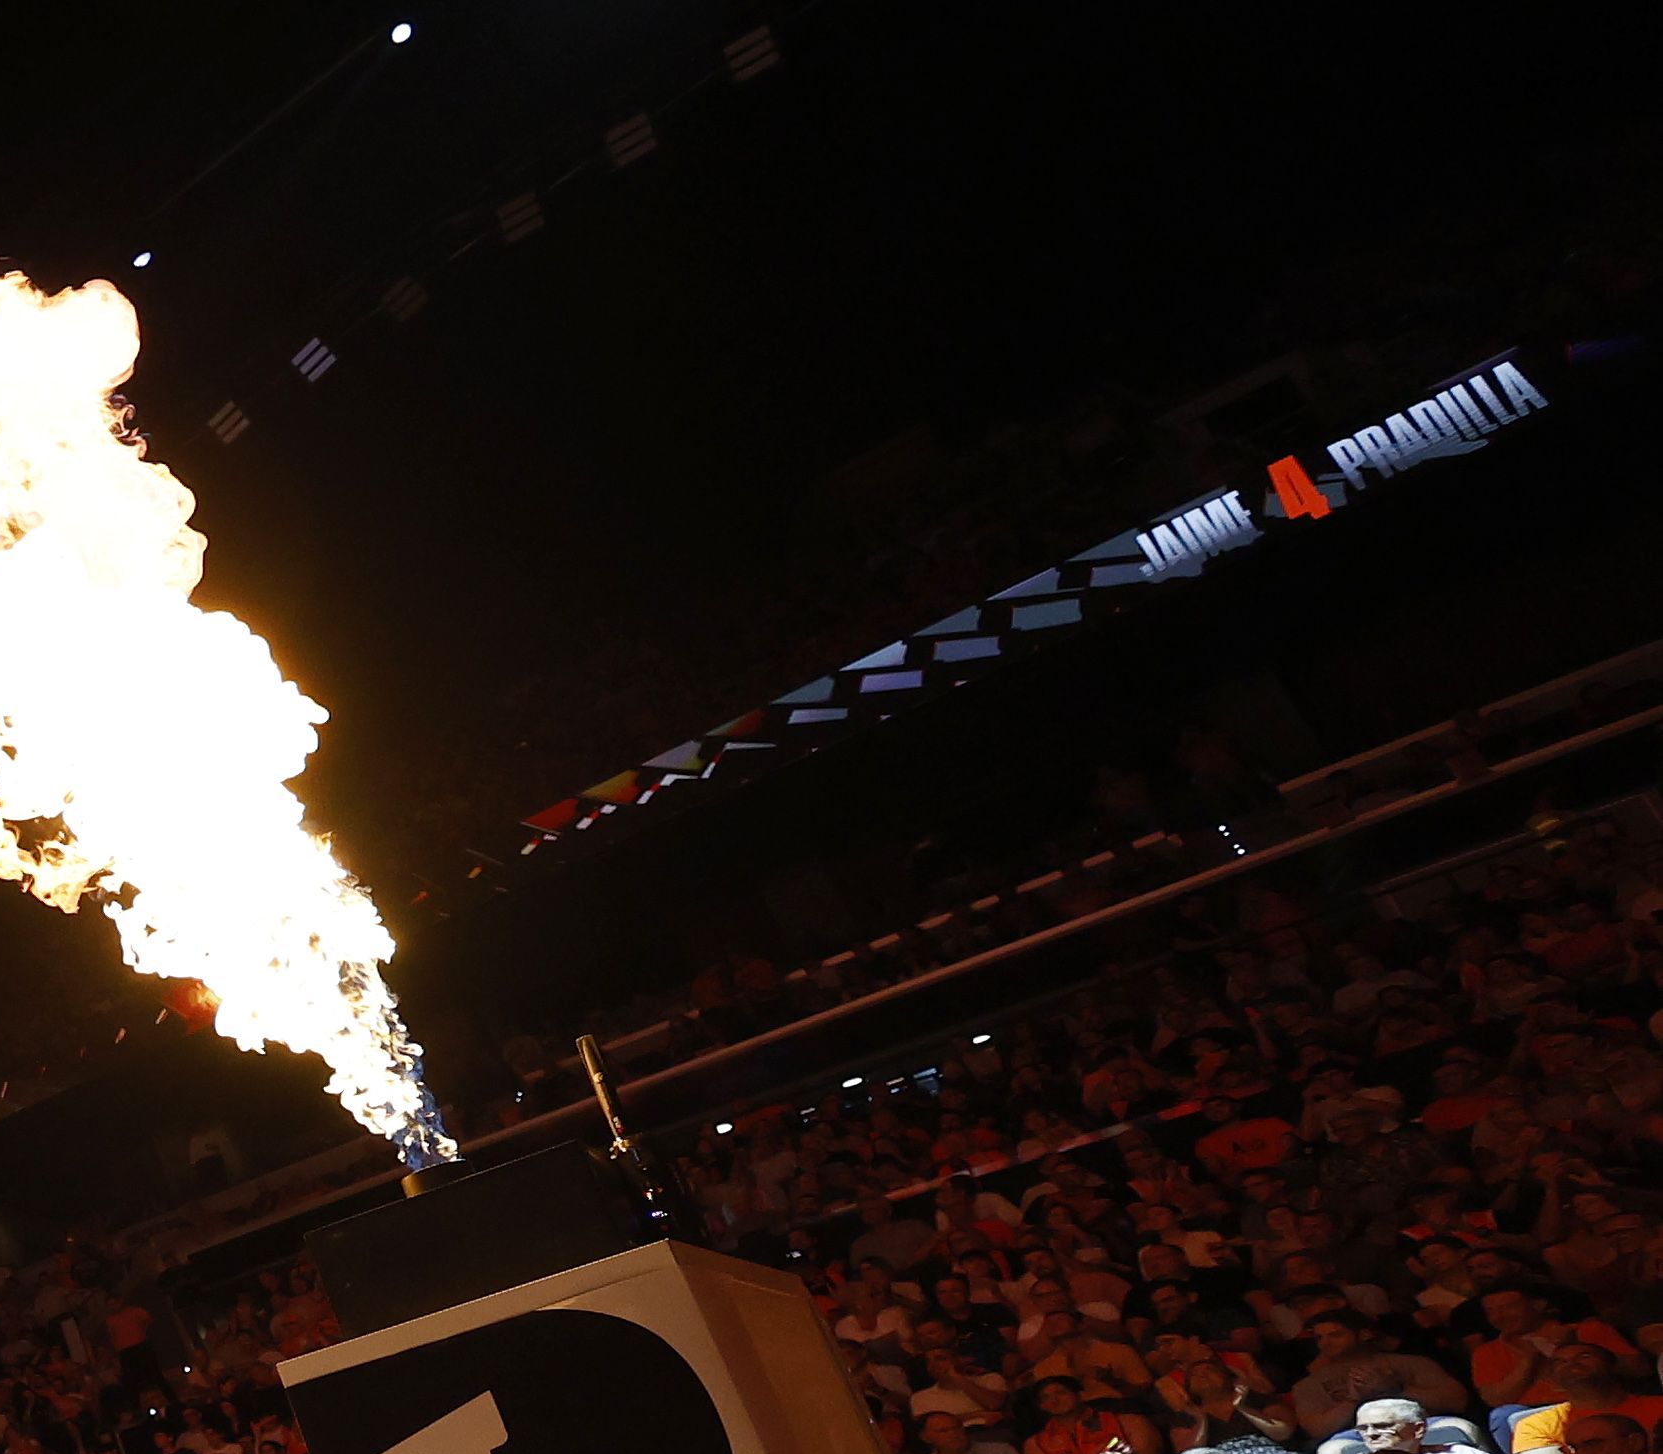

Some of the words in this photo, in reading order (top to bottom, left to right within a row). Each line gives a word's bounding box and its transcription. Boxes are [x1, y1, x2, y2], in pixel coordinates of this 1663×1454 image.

[1136, 490, 1262, 578] JAIME
[1267, 455, 1332, 519] 4
[1326, 361, 1550, 490] PRADILLA
